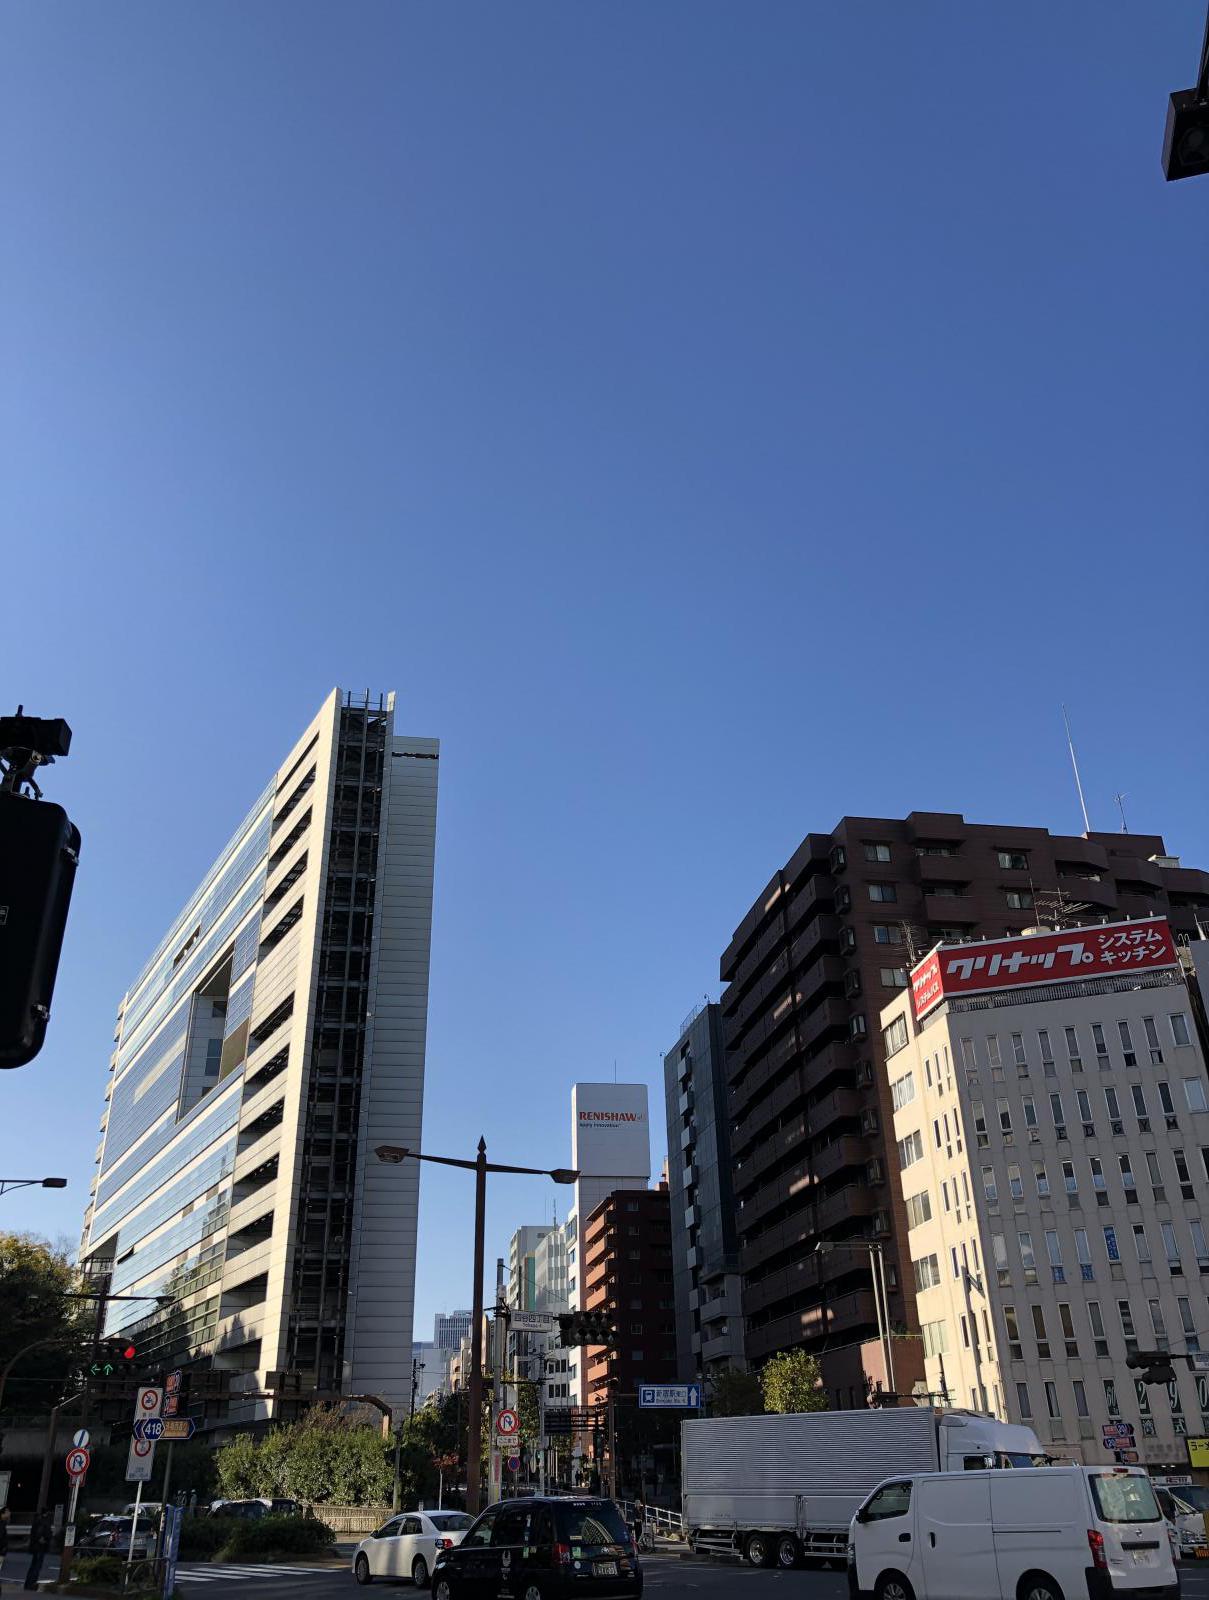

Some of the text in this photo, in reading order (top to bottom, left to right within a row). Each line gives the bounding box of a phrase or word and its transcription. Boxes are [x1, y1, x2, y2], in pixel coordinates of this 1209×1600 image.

[1098, 929, 1163, 949] システム
[946, 943, 1095, 980] クリナップ
[1100, 945, 1167, 966] キッチン
[579, 1111, 636, 1121] RENISHAW
[145, 1423, 162, 1435] 418
